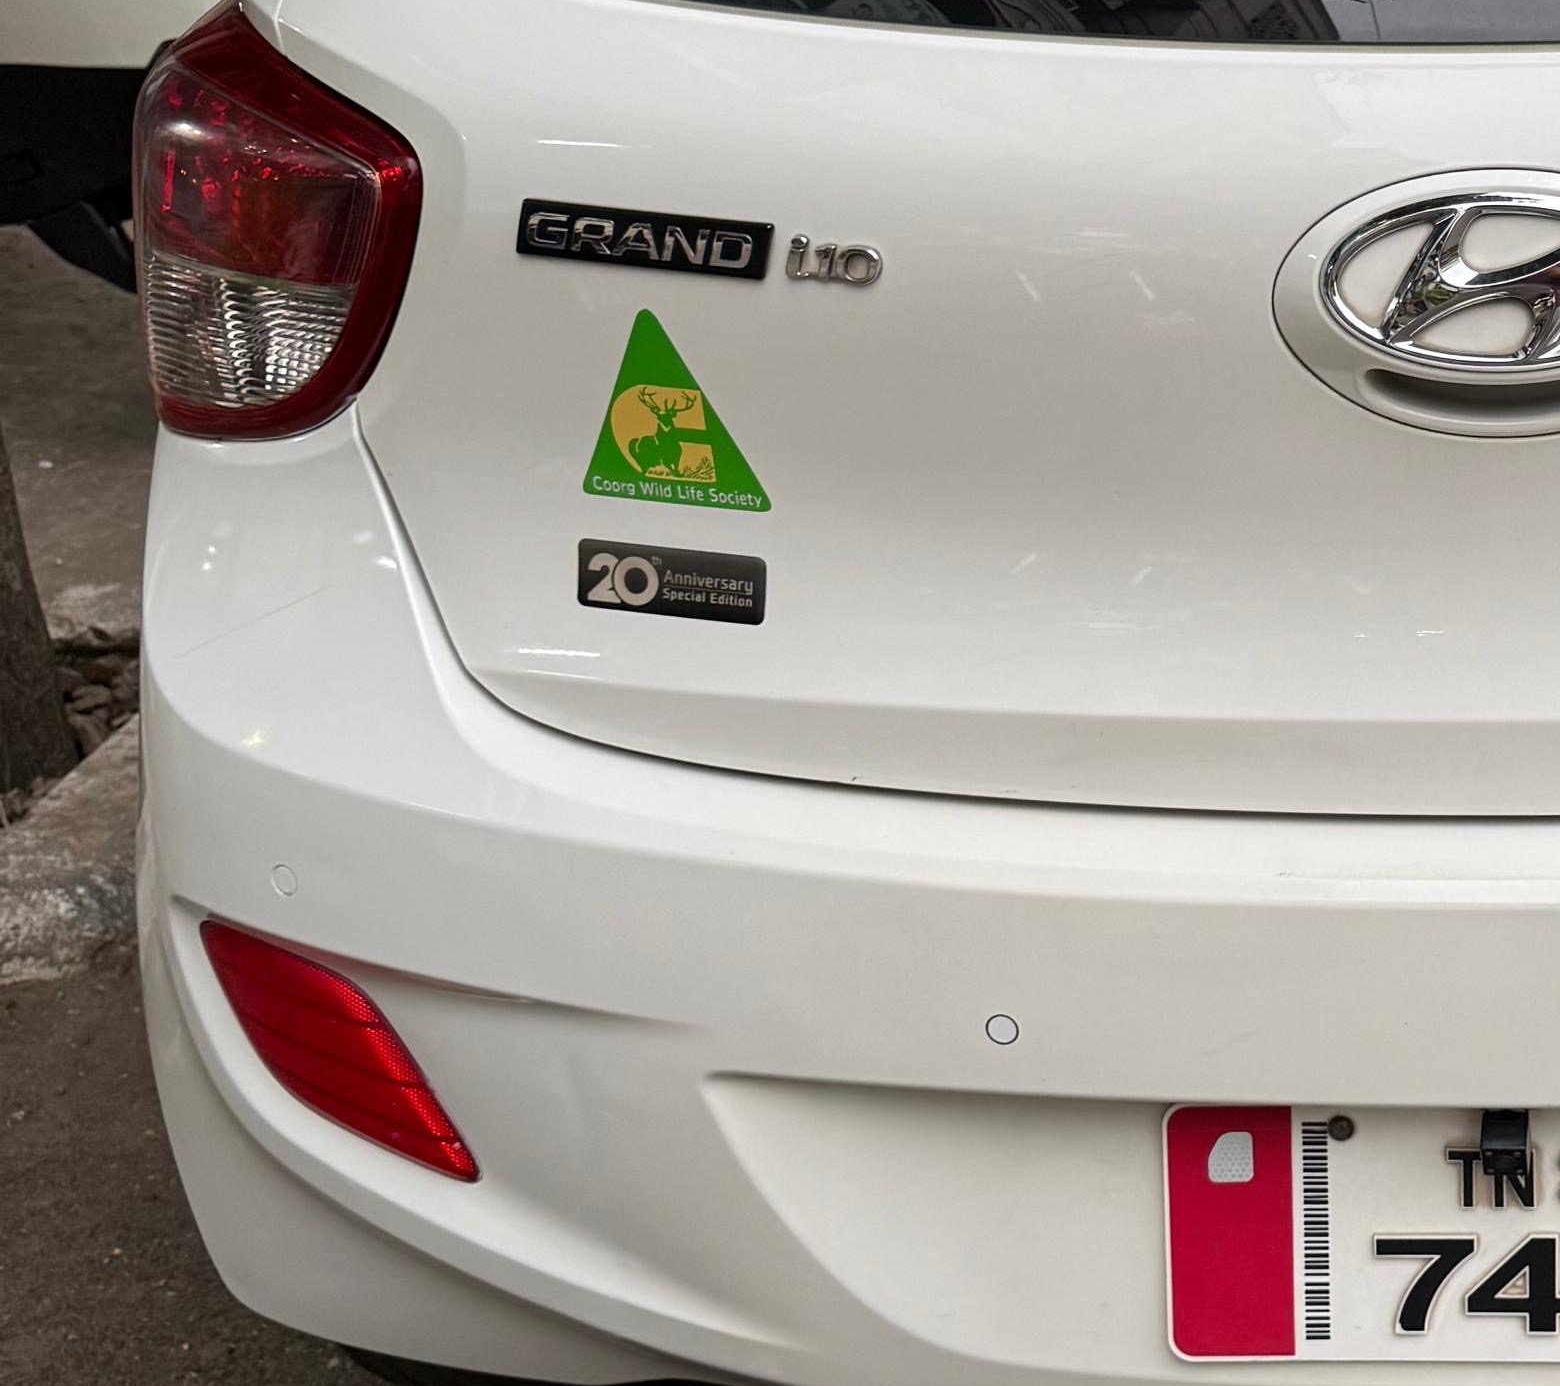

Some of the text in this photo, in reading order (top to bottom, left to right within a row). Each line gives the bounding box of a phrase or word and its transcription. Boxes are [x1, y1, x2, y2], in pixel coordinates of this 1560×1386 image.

[527, 211, 884, 287] GRAND i10
[592, 475, 763, 508] Coorg Wild Life Society
[662, 587, 753, 608] Special Edition
[664, 570, 754, 595] Anniversary
[1445, 1148, 1536, 1209] TN
